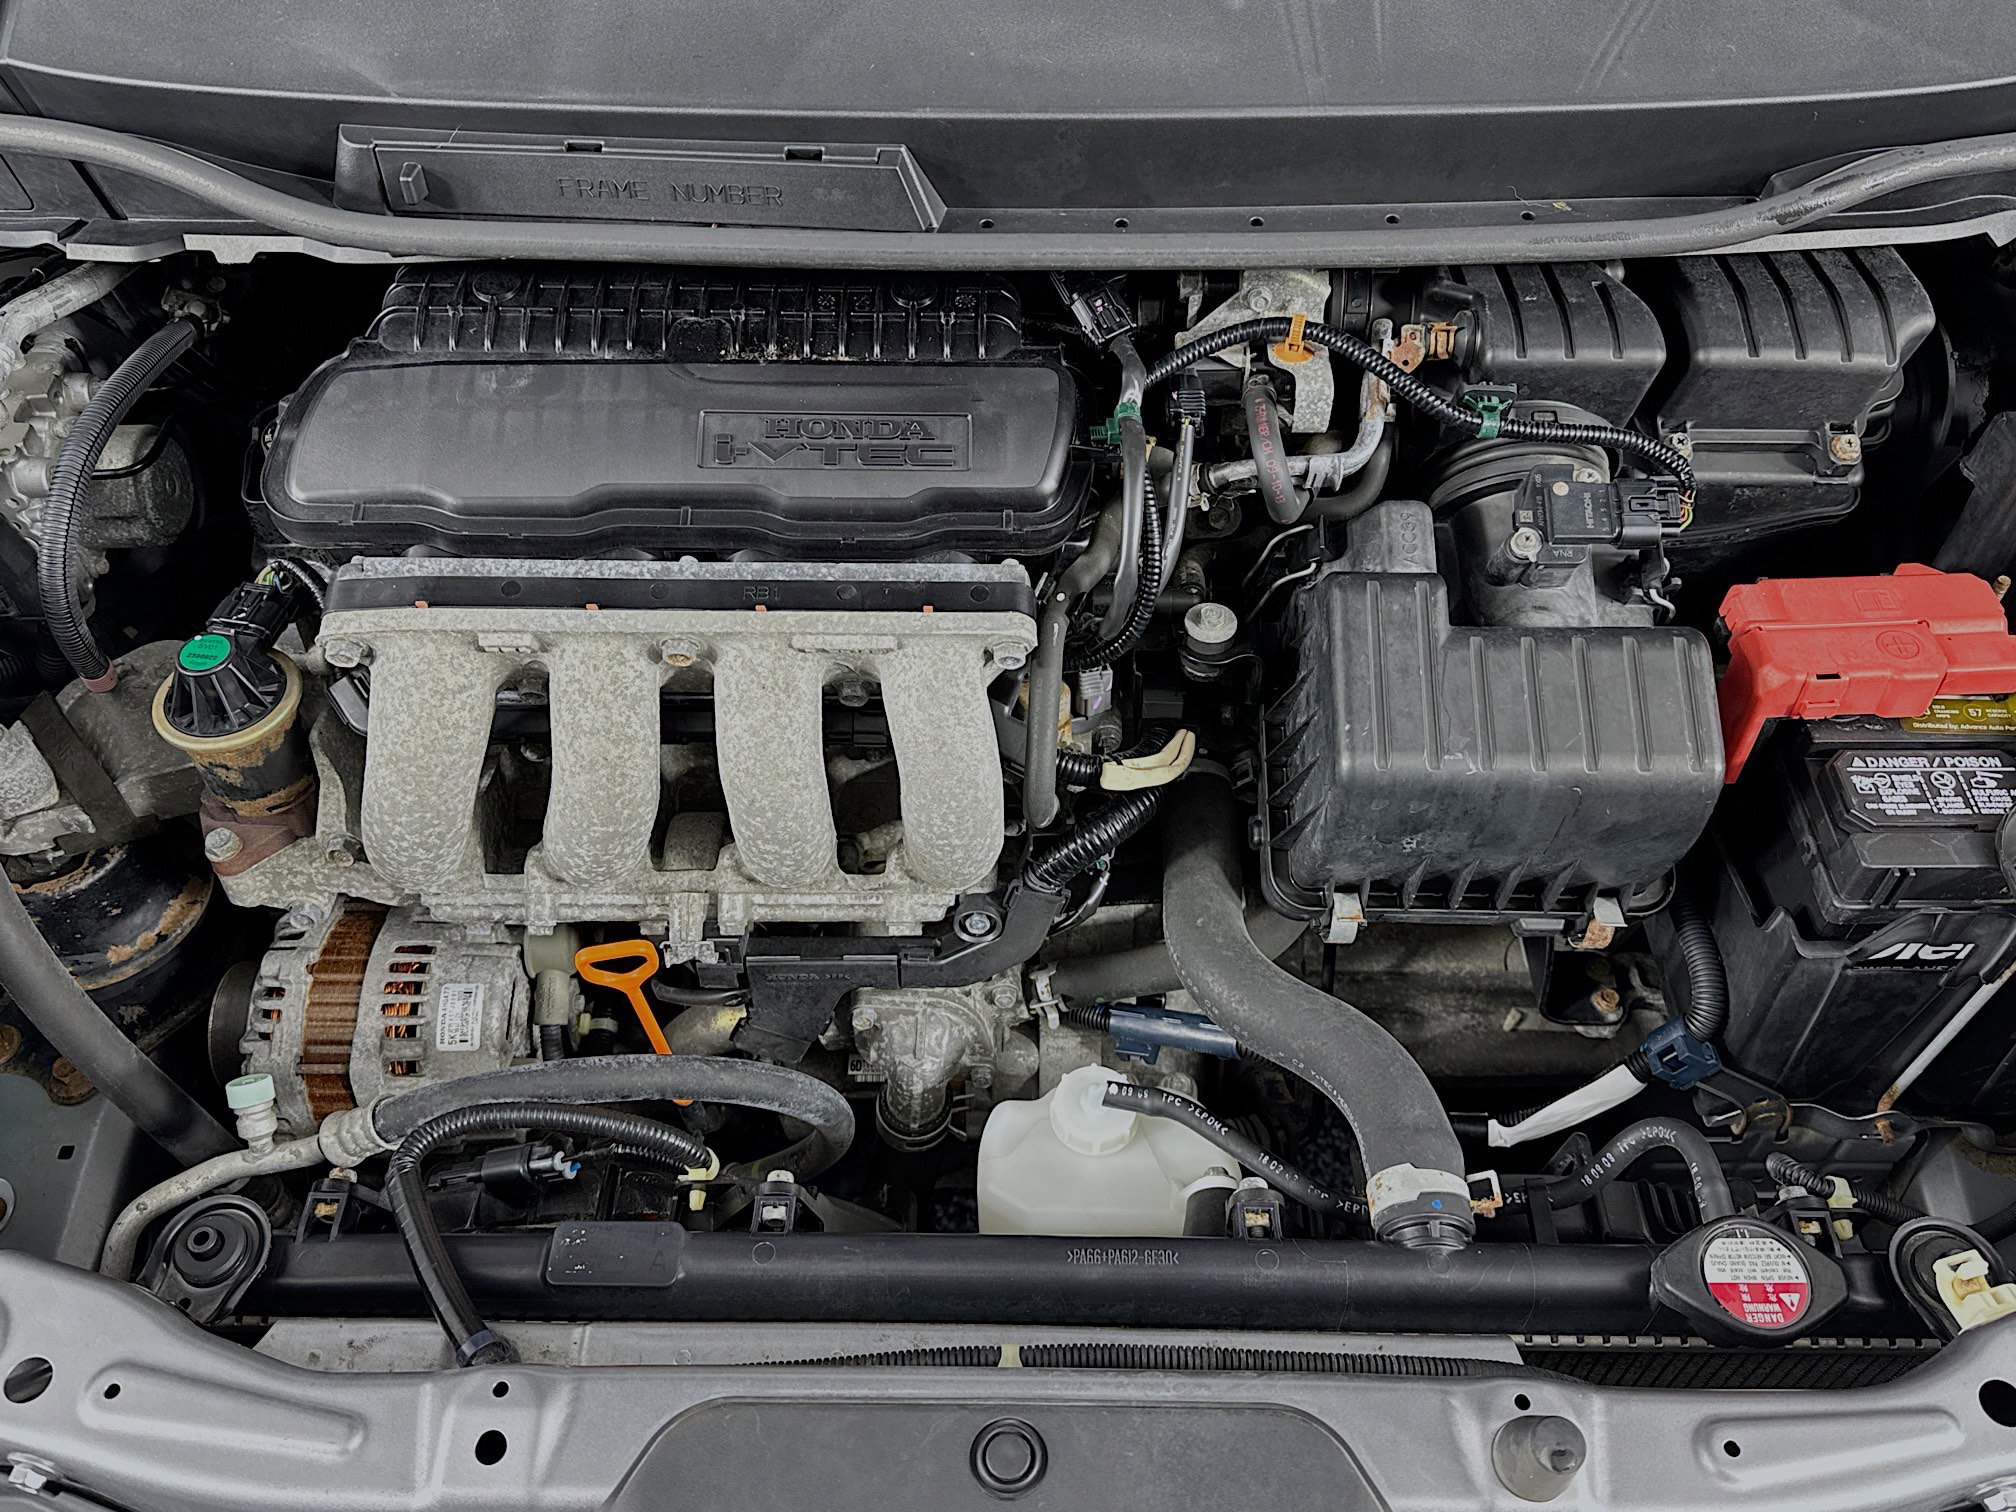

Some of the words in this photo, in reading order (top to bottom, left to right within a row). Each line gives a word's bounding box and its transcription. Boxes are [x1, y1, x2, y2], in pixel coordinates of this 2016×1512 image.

[557, 177, 649, 200] FRAME
[671, 182, 783, 206] NUMBER
[765, 419, 936, 440] HONDA
[715, 433, 955, 466] i-VTEC
[1583, 492, 1595, 529] HITACHI
[1967, 708, 1983, 717] 57
[1912, 722, 1948, 730] Distributed
[1865, 757, 1930, 768] DANGER
[1943, 757, 2002, 768] POISON
[1743, 1303, 1782, 1312] WARNUNG
[1745, 1313, 1785, 1323] DANGER
